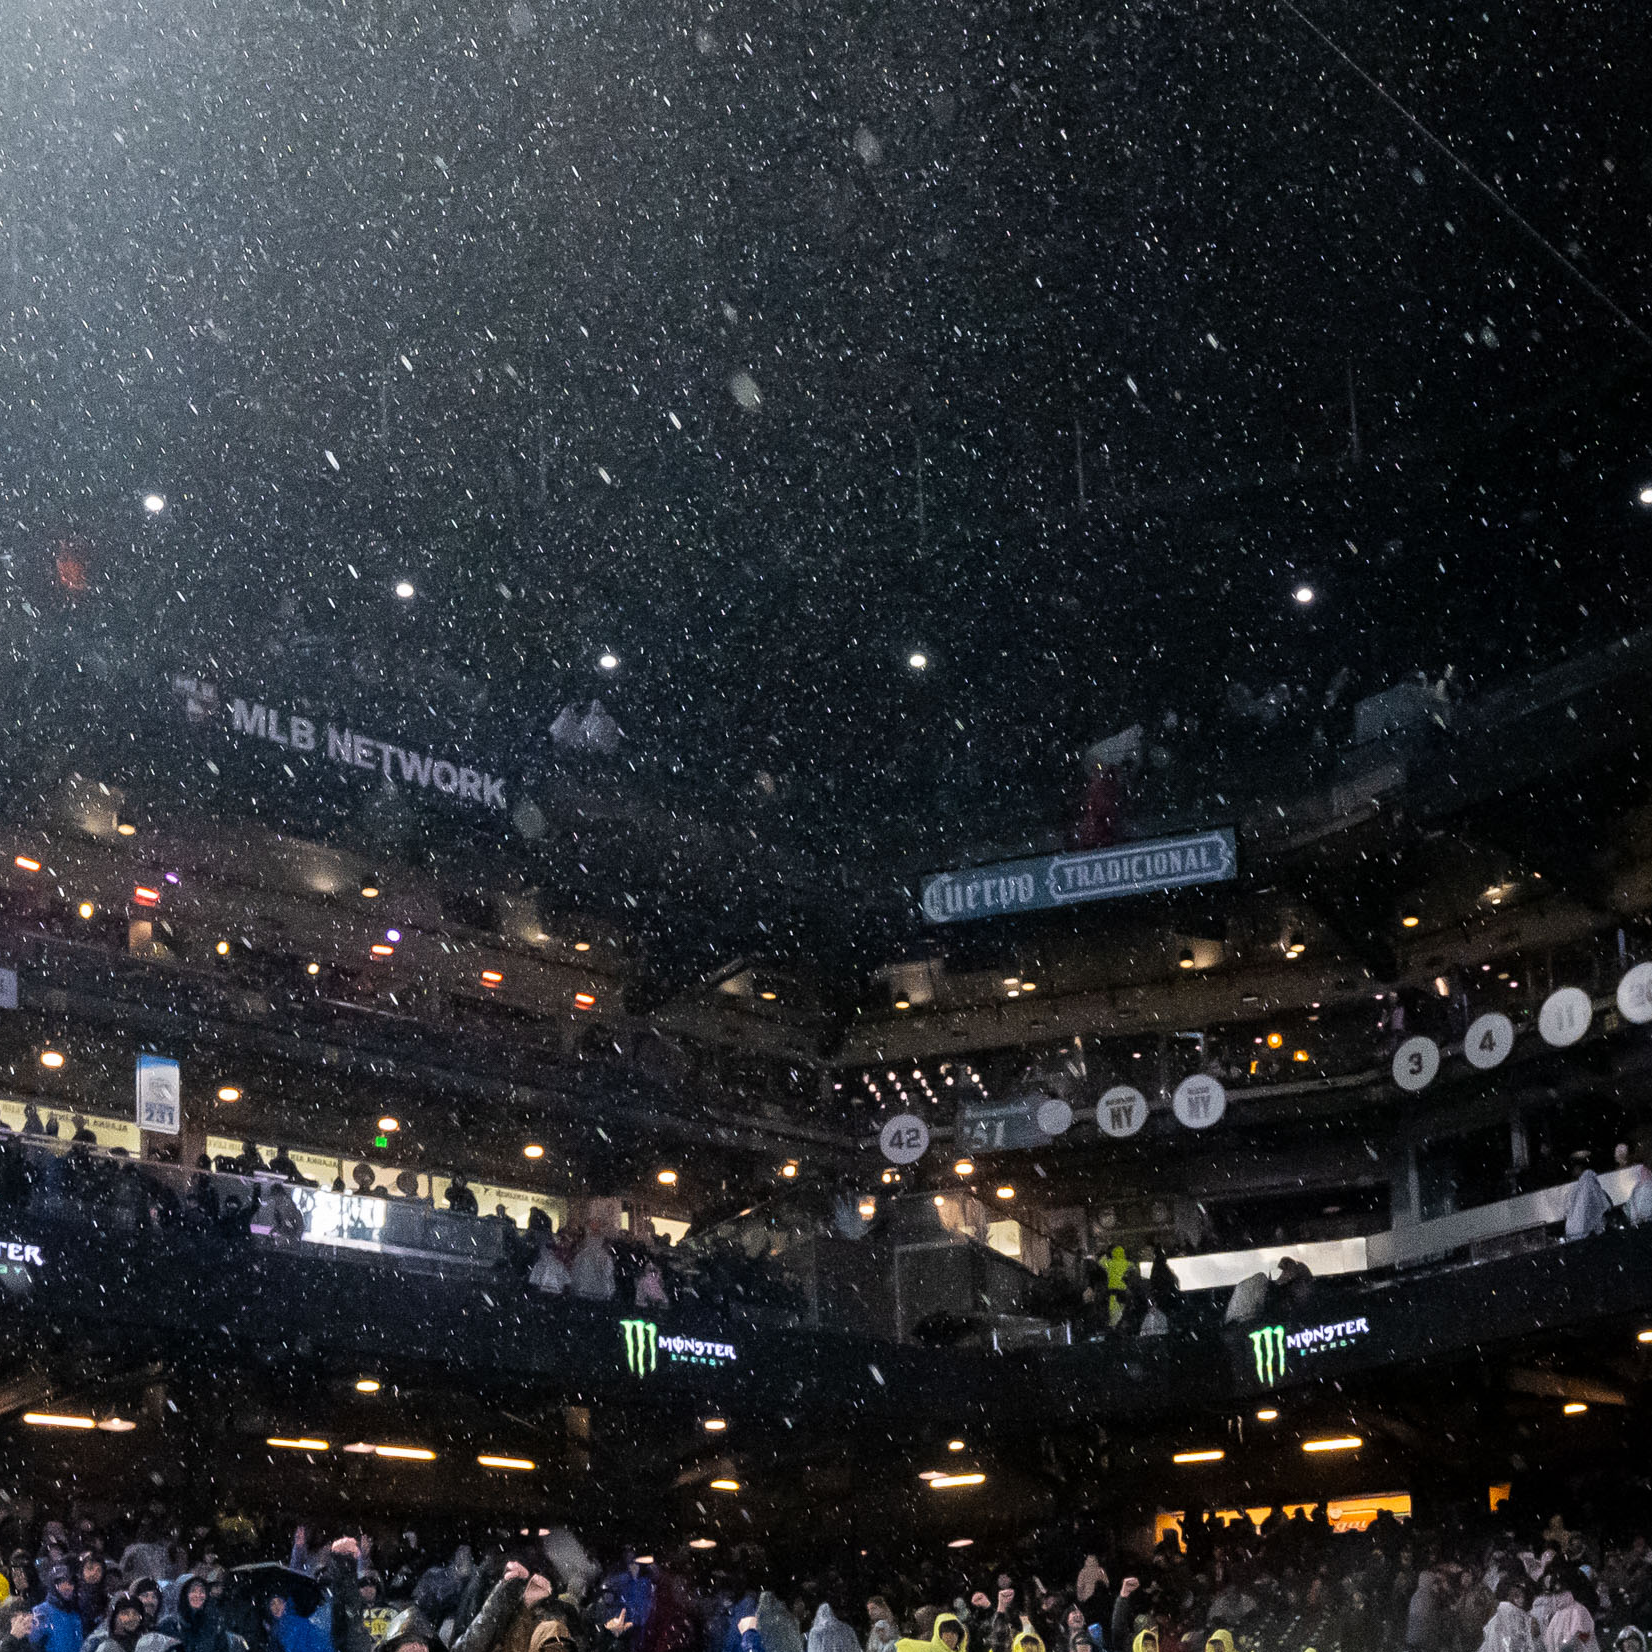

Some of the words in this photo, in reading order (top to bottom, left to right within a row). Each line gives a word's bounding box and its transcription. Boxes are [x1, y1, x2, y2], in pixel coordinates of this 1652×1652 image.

[231, 698, 315, 751] MLB
[327, 726, 507, 809] NETWORK
[1063, 847, 1212, 890] TRADICIONAL
[1479, 1029, 1496, 1052] 4
[1408, 1052, 1424, 1075] 3
[888, 1128, 922, 1151] 42
[1286, 1317, 1370, 1349] MONSTER
[659, 1335, 737, 1360] MONSTER
